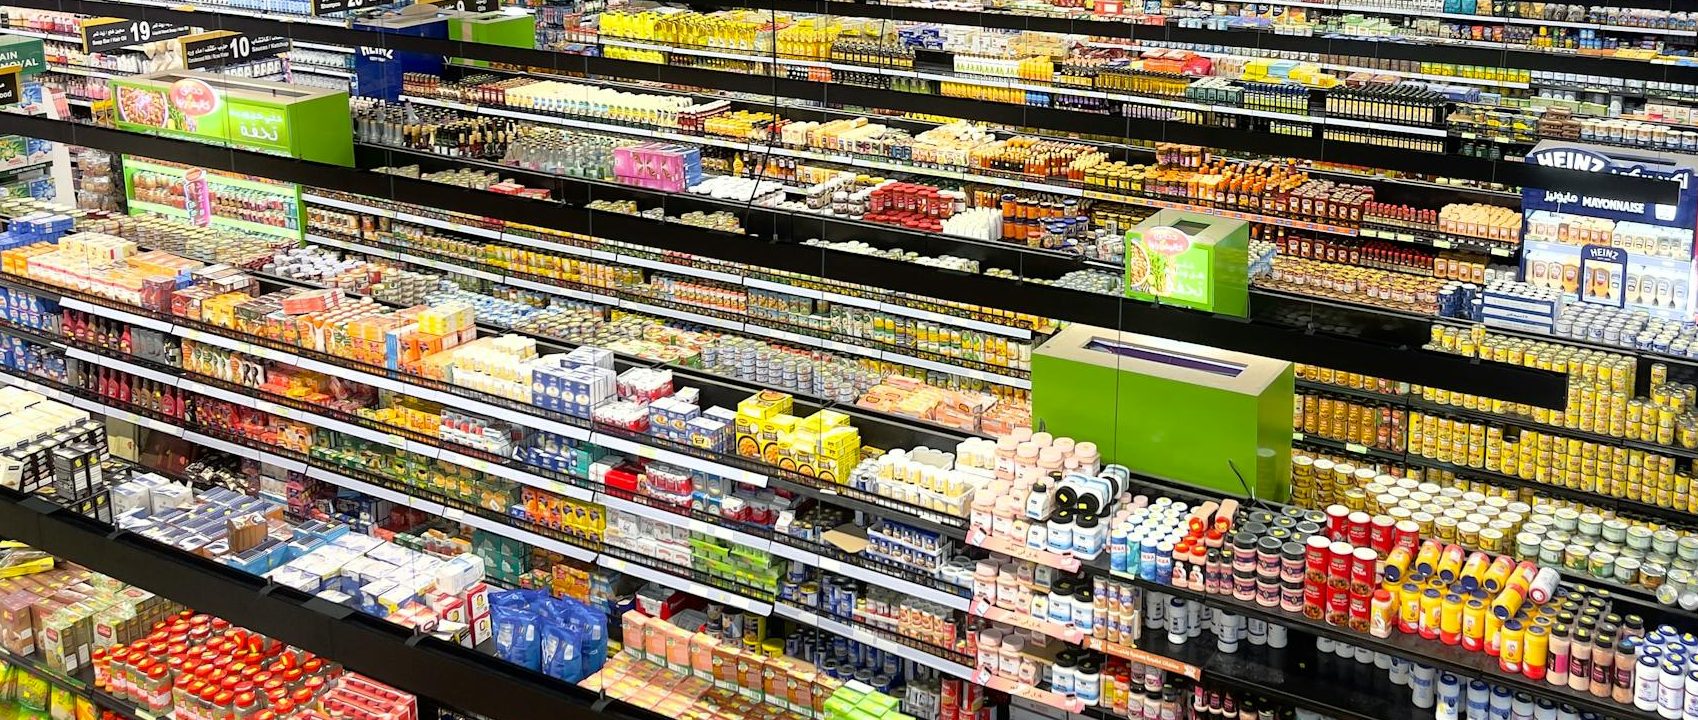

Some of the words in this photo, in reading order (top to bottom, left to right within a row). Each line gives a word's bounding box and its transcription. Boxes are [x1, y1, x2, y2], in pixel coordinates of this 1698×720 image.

[130, 21, 150, 42] 19
[230, 36, 250, 59] 10
[1536, 151, 1605, 172] HEINZ
[1582, 196, 1645, 214] MAYONNAISE
[1590, 248, 1619, 260] HEINZ
